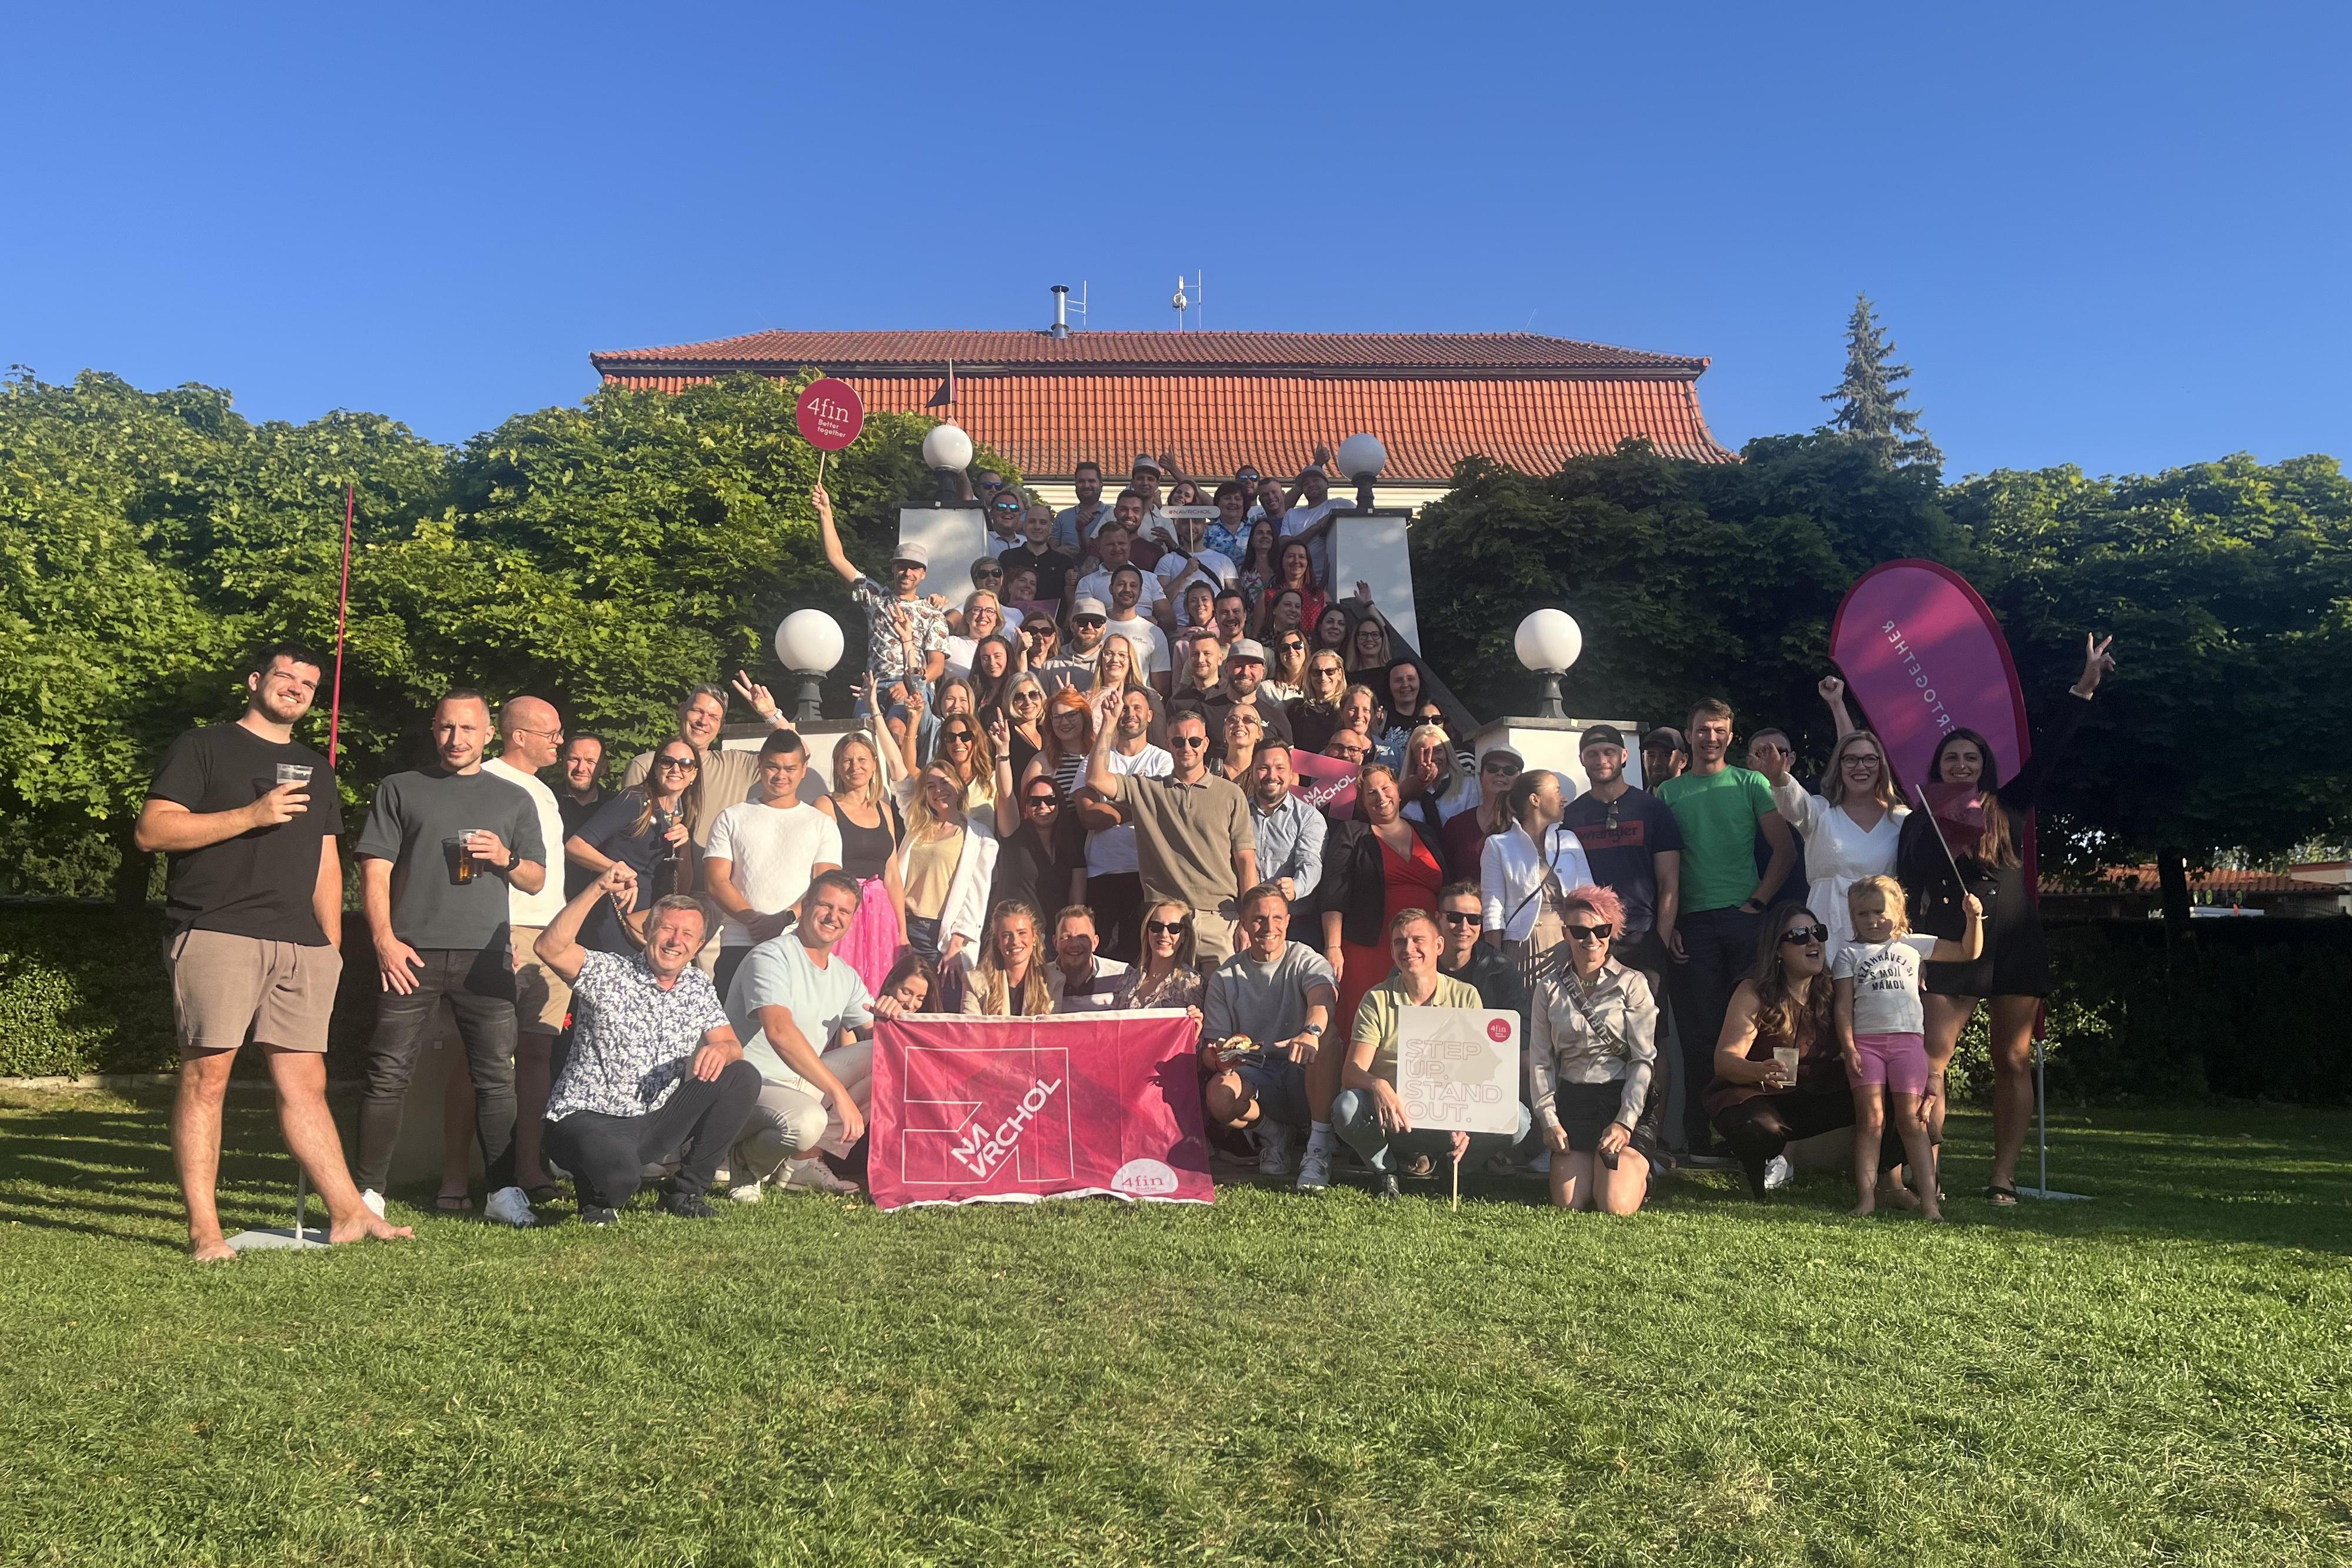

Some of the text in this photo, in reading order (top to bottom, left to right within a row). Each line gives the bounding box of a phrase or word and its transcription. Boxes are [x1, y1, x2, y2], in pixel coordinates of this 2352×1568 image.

[807, 397, 849, 423] 4fin
[817, 426, 846, 438] together
[818, 419, 839, 429] Better
[1302, 786, 1321, 803] NA
[1870, 971, 1876, 980] S
[1581, 1001, 1615, 1045] FURLA
[1405, 1039, 1482, 1060] STEP
[1405, 1059, 1449, 1080] UP.
[1405, 1080, 1502, 1104] STAND
[1404, 1101, 1472, 1123] OUT.
[968, 1078, 1062, 1178] VRCHOL
[951, 1122, 990, 1165] NA
[1122, 1175, 1165, 1187] 4fin
